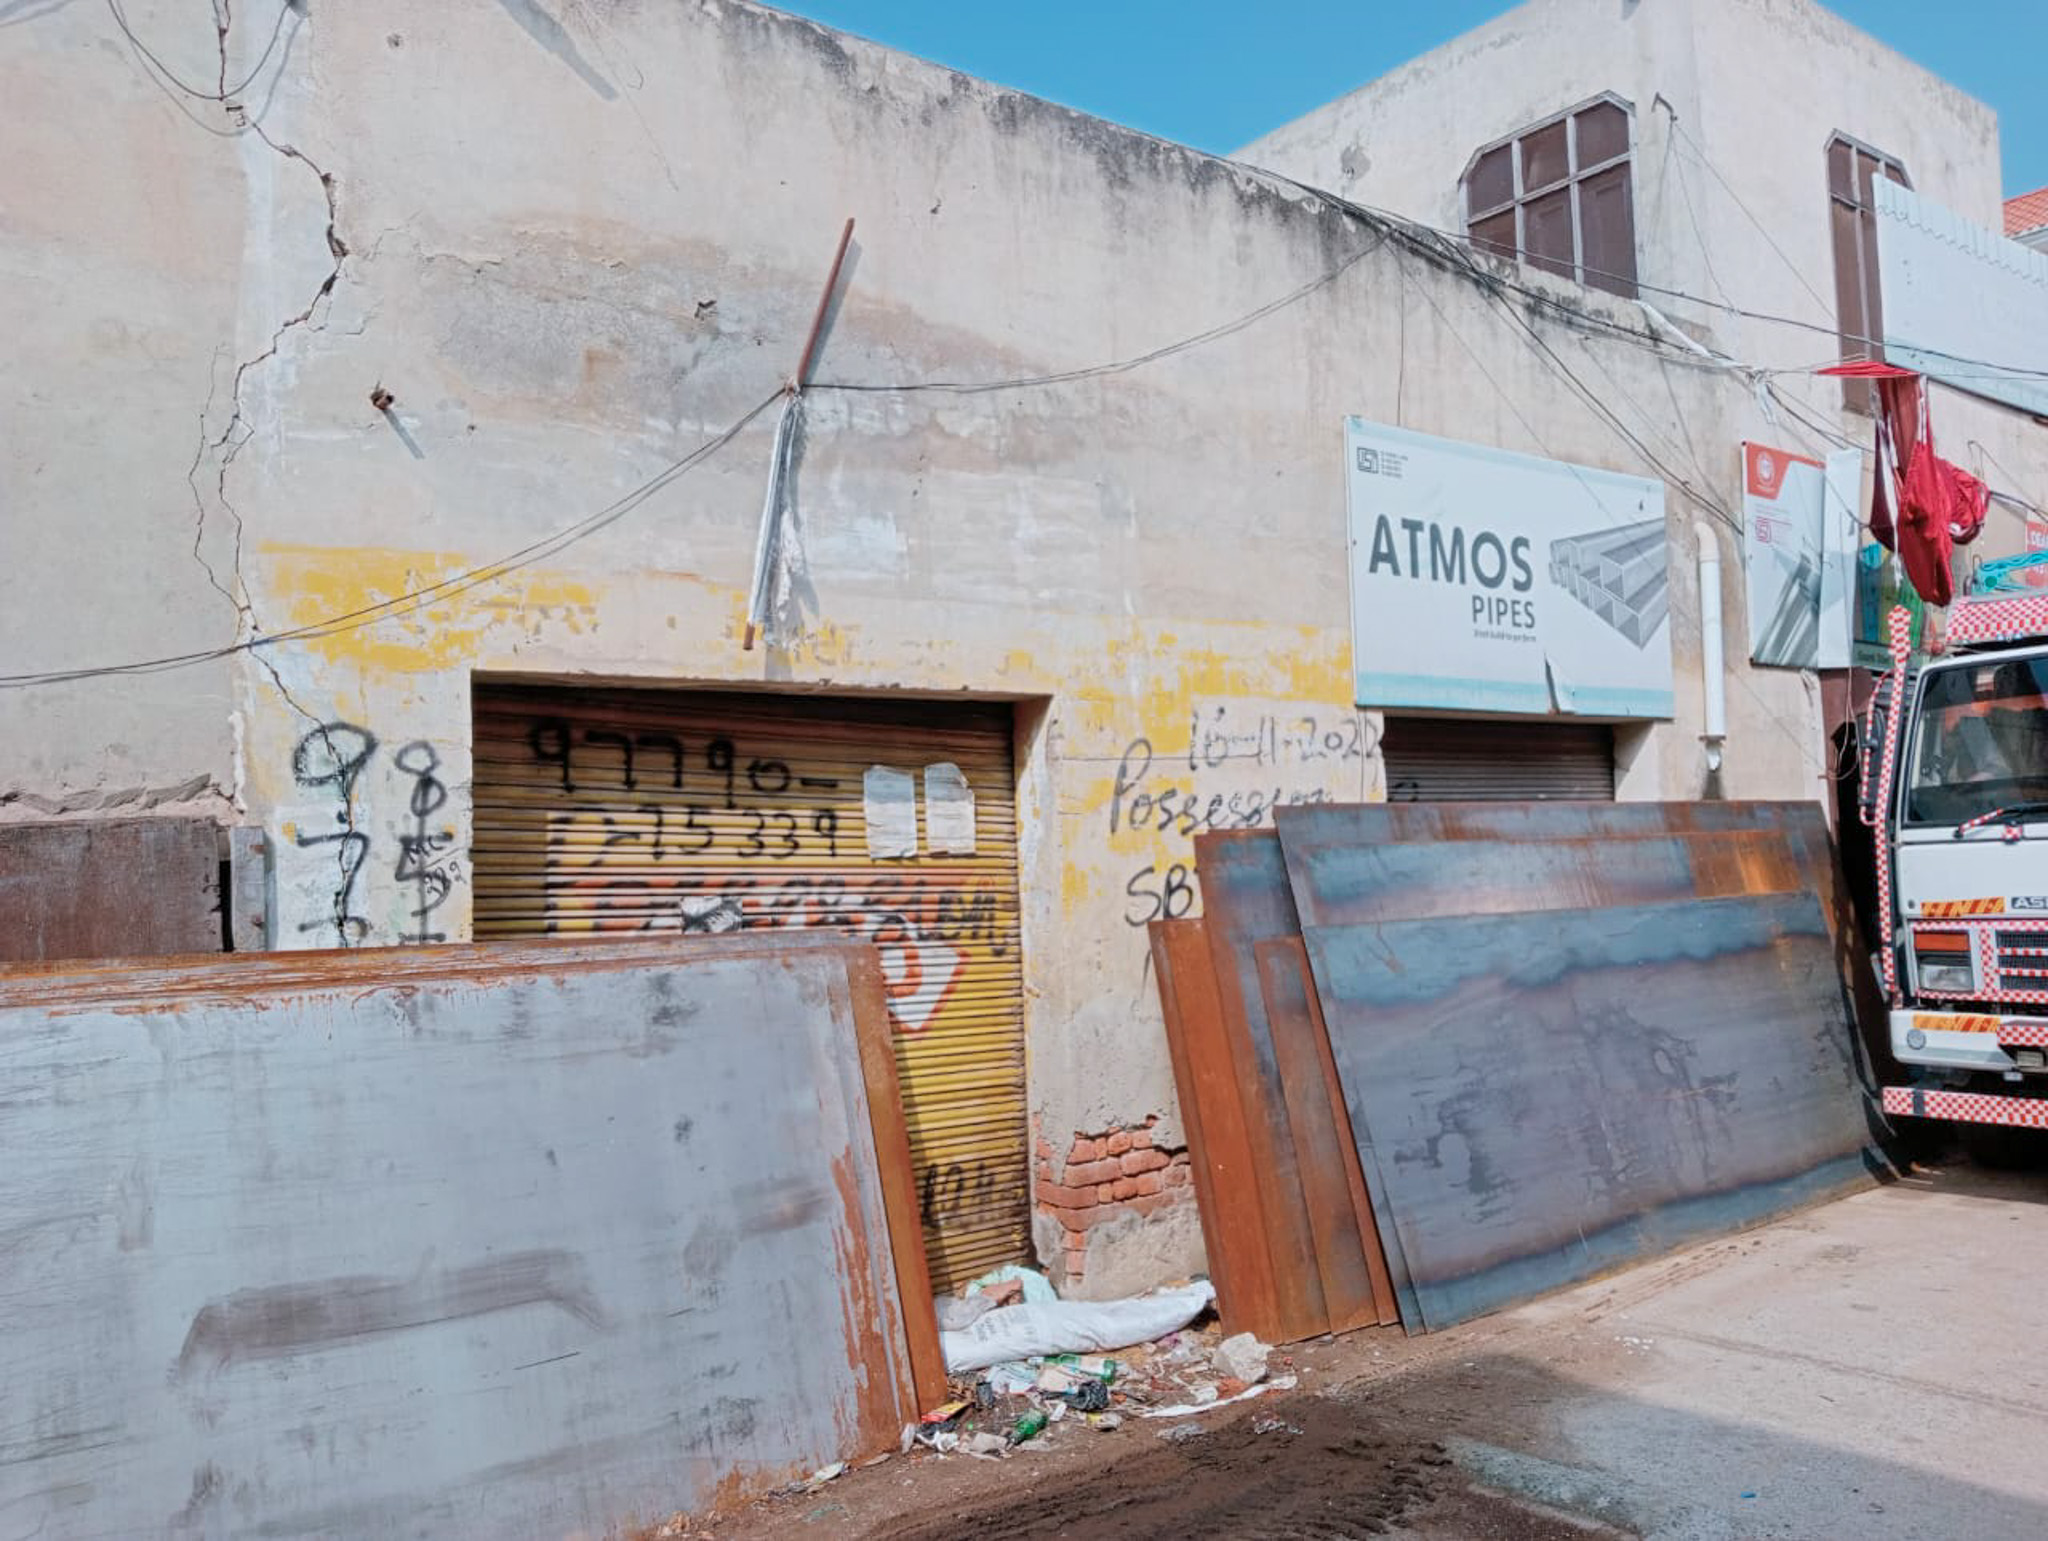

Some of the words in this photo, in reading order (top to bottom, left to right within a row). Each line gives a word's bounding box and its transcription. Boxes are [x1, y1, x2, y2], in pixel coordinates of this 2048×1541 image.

[1368, 513, 1534, 592] ATMOS
[1471, 594, 1536, 629] PIPES
[1124, 864, 1200, 927] SB
